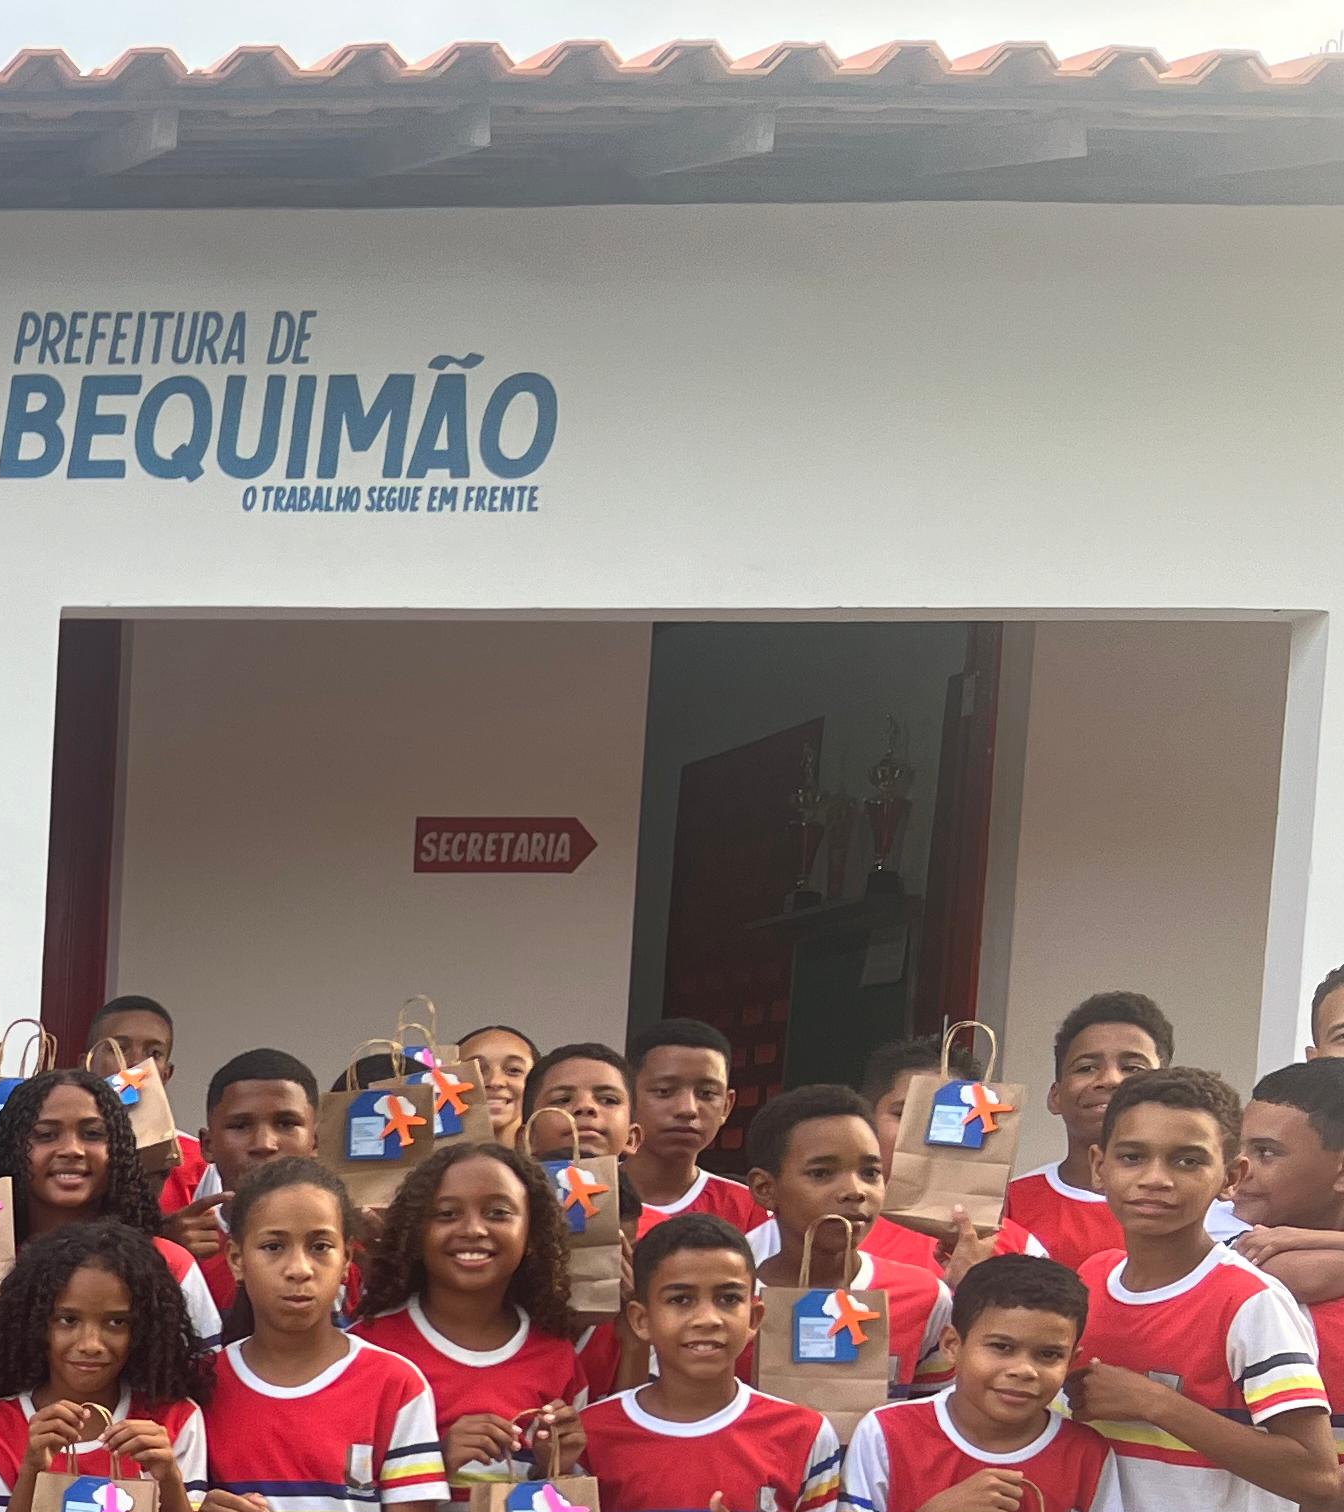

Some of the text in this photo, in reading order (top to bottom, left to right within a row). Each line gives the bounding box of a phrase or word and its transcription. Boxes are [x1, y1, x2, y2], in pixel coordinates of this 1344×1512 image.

[14, 310, 317, 365] PREFEITURA DE
[242, 486, 539, 513] O TRABALHO SEGUE EM FRENTE
[419, 831, 572, 863] SECRETARIA
